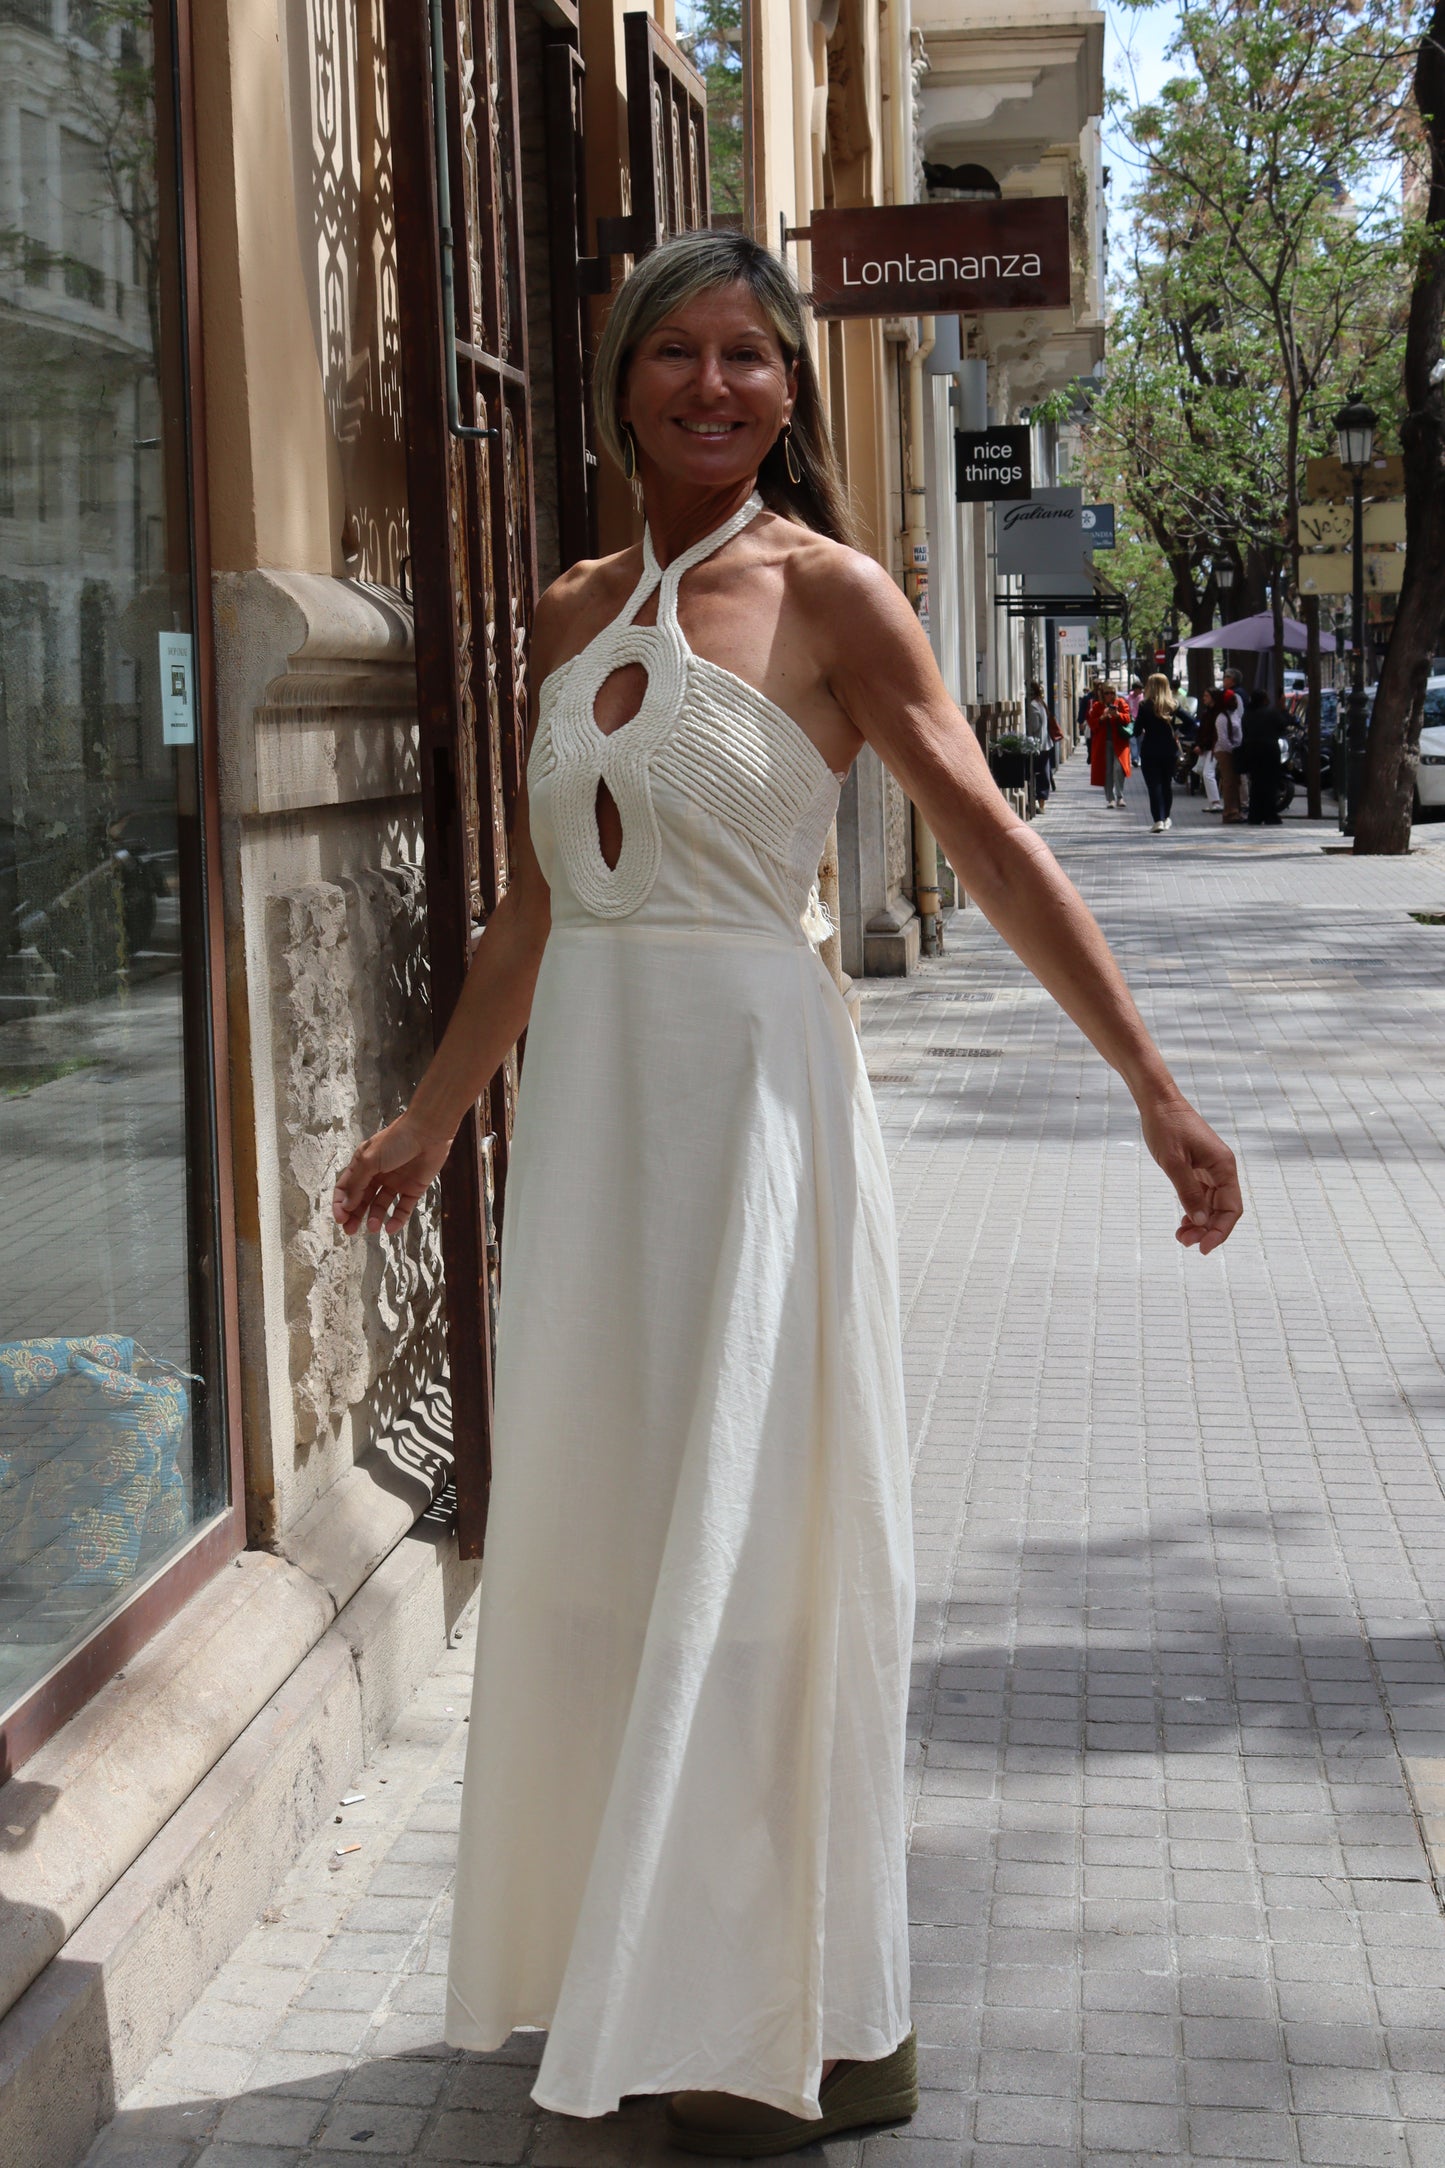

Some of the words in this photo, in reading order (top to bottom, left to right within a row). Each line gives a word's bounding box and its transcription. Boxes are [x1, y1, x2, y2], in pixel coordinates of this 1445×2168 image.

[842, 252, 1041, 286] Lontananza
[974, 442, 1013, 459] nice
[965, 464, 1023, 485] things
[1003, 503, 1076, 531] Galiana
